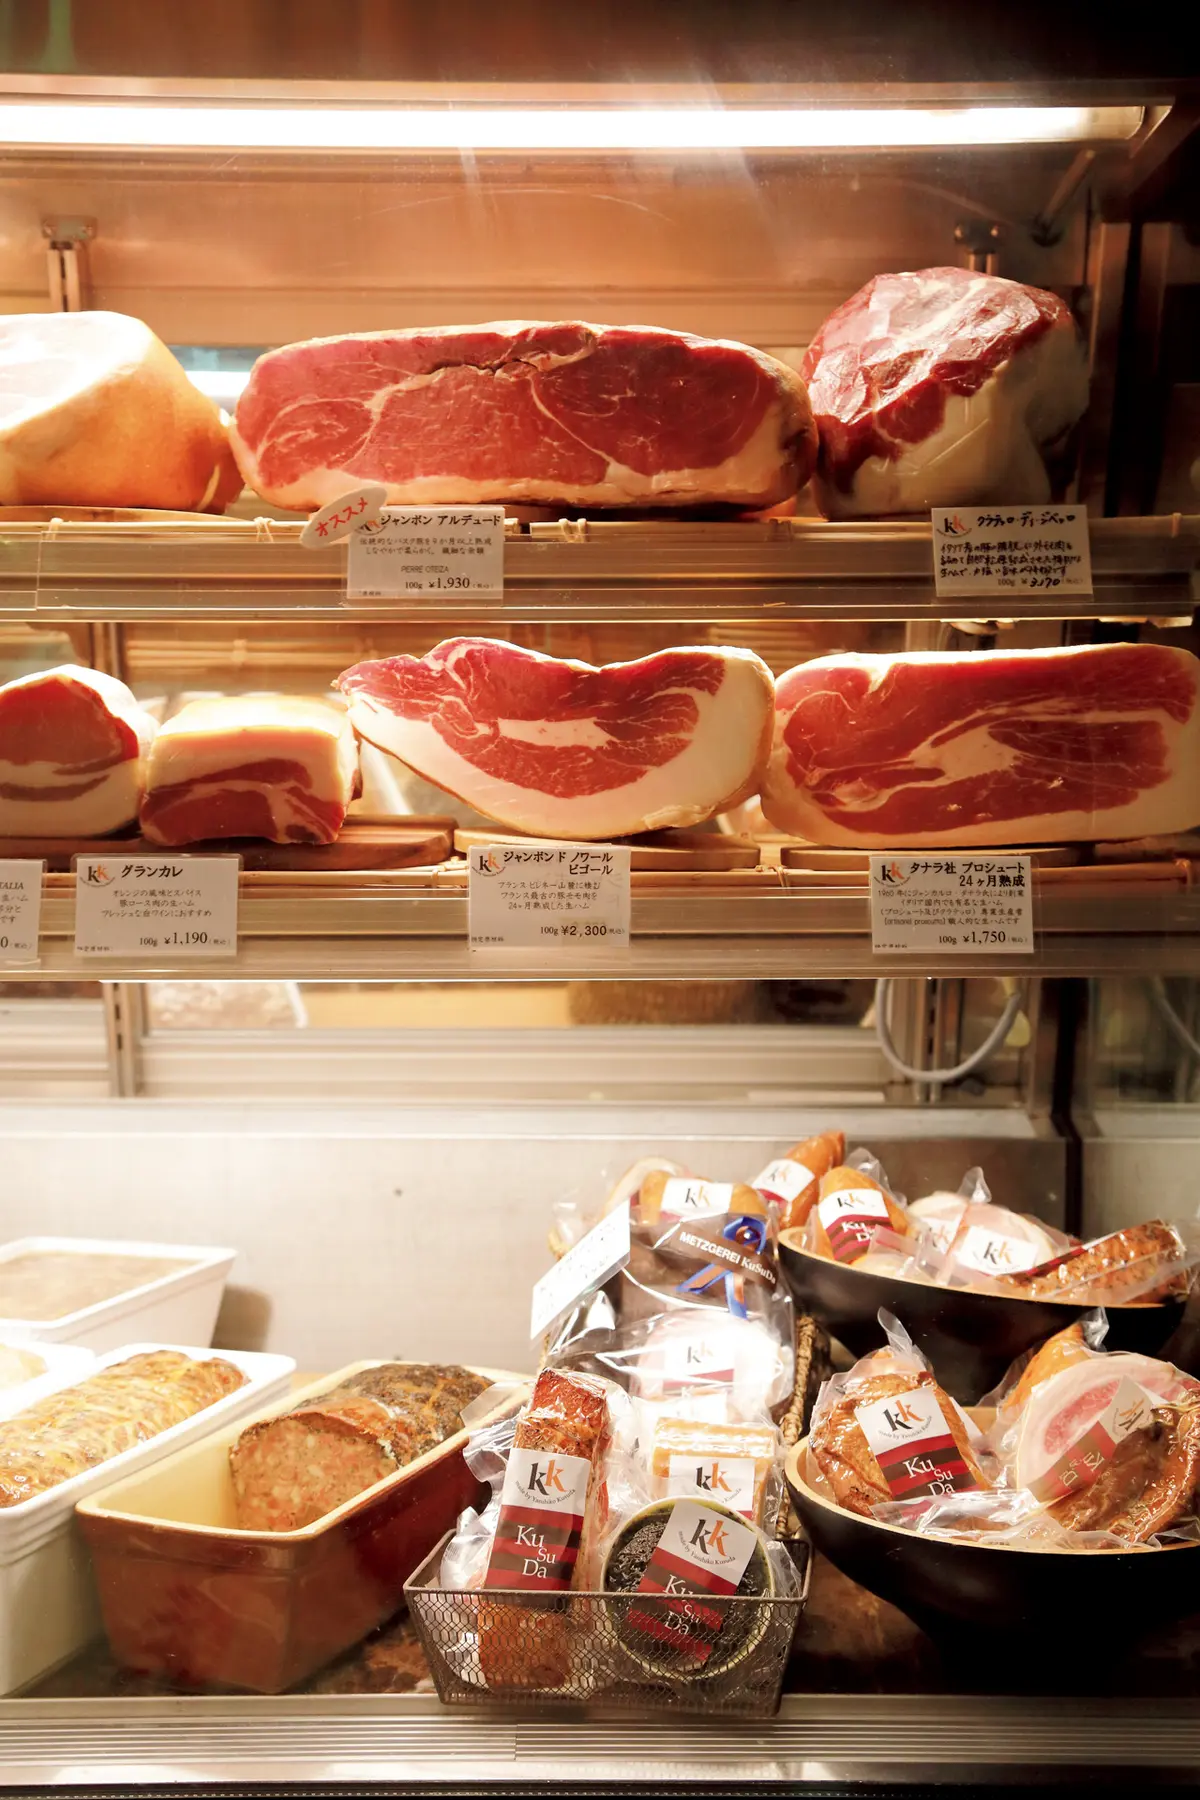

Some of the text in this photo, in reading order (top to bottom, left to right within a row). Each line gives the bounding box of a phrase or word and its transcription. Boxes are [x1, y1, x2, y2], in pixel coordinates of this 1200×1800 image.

[315, 497, 368, 537] オススメ
[380, 514, 501, 527] ジャンボン アルデュード
[405, 581, 423, 590] 100g
[503, 851, 555, 863] ジャンボン
[570, 851, 614, 863] ノワール
[121, 864, 184, 879] グランカレ
[569, 864, 614, 875] ビゴール
[910, 862, 1025, 875] タナラ社 プロシュート
[959, 875, 1026, 888] 24ヶ月熟成
[113, 889, 202, 898] オレンジの風味とスパイス
[119, 899, 195, 908] 豚ロース肉の生ハム
[102, 908, 213, 918] フレッシュな白ワインにおすすめ
[540, 926, 559, 937] 100g
[561, 925, 607, 939] ¥2,300
[938, 935, 958, 945] 100g
[963, 931, 1006, 945] ¥1,750
[139, 937, 158, 948] 100g
[163, 932, 208, 946] ¥1,190
[679, 1231, 777, 1285] METZGEREI KuSuDa
[902, 1456, 935, 1479] Ku
[933, 1468, 955, 1483] Su
[928, 1481, 956, 1497] Da
[514, 1525, 545, 1548] Ku
[536, 1548, 556, 1564] Su
[521, 1558, 548, 1579] Da
